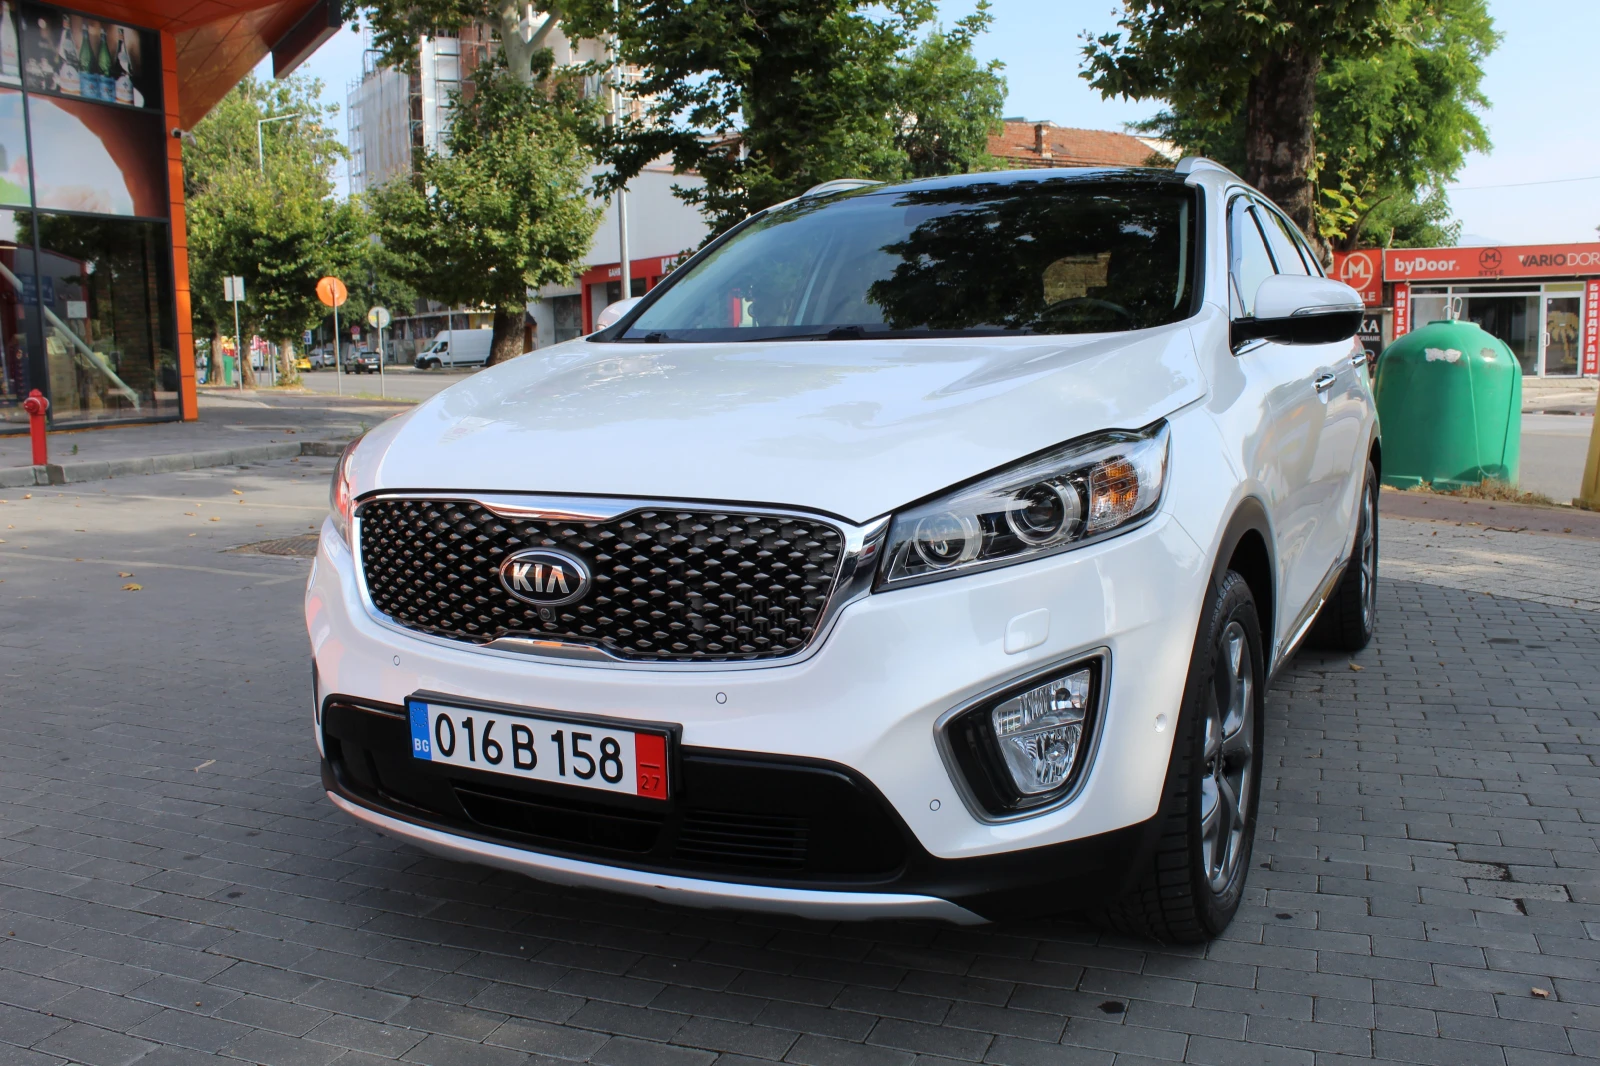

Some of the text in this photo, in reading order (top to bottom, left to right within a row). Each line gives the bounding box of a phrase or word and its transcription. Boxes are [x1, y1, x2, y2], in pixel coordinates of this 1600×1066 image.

[1394, 257, 1456, 275] byDoor
[513, 563, 570, 594] KIA
[414, 738, 430, 753] BG
[641, 774, 660, 791] 27
